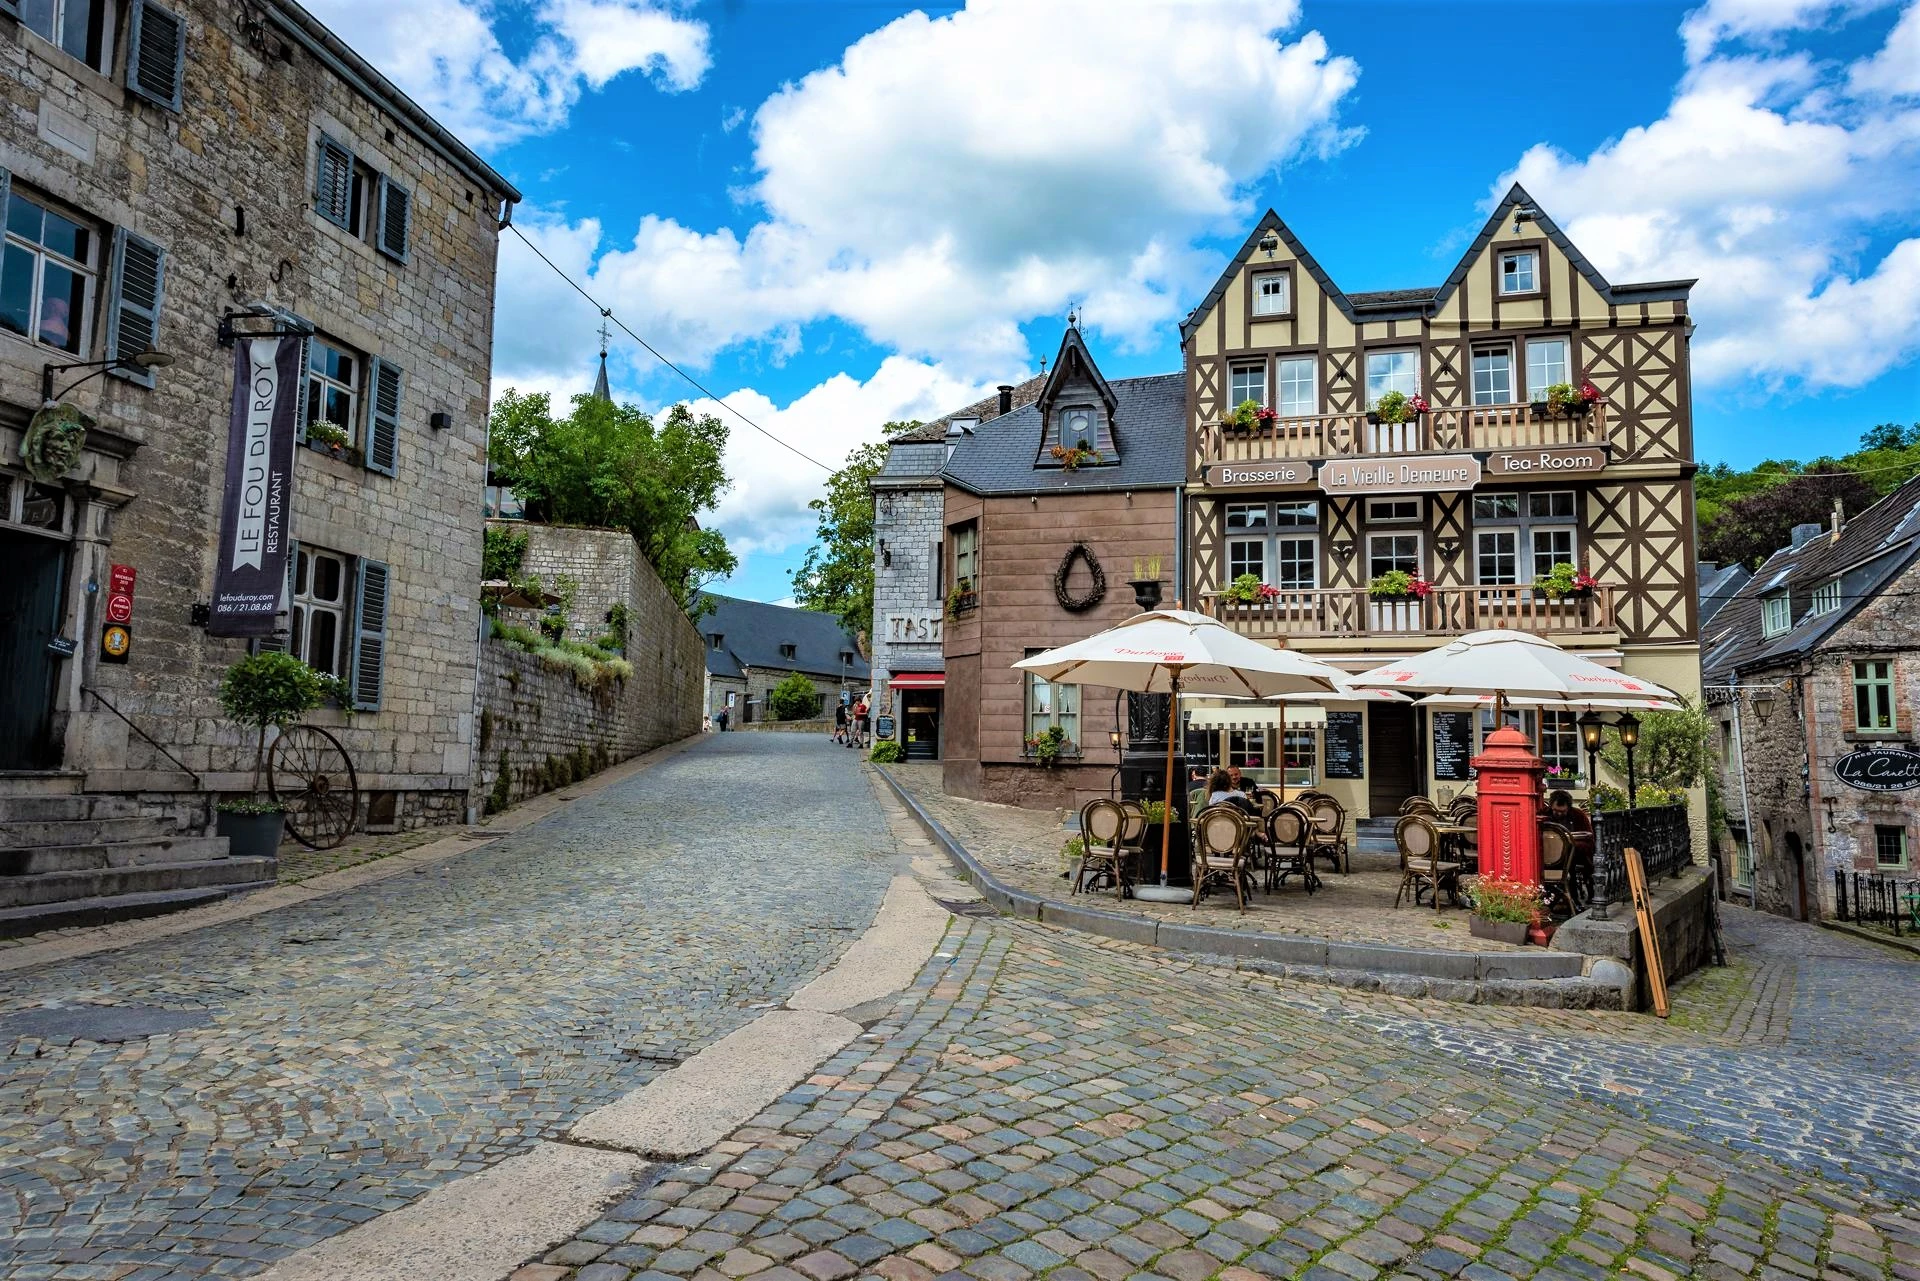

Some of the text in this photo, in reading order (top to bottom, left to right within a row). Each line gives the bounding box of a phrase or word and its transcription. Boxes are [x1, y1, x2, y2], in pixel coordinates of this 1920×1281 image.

[239, 362, 273, 553] LE FOU DU ROY
[1500, 453, 1593, 471] Tea-Room
[1222, 466, 1296, 484] Brasserie
[1331, 463, 1468, 487] La Vieille Demeure
[266, 470, 283, 553] RESTAURANT
[219, 593, 275, 603] lefouduroy.com
[217, 604, 233, 613] 086
[239, 603, 273, 613] 21.08.68
[1854, 751, 1914, 759] RESTAURANT
[1843, 756, 1920, 777] La Canett
